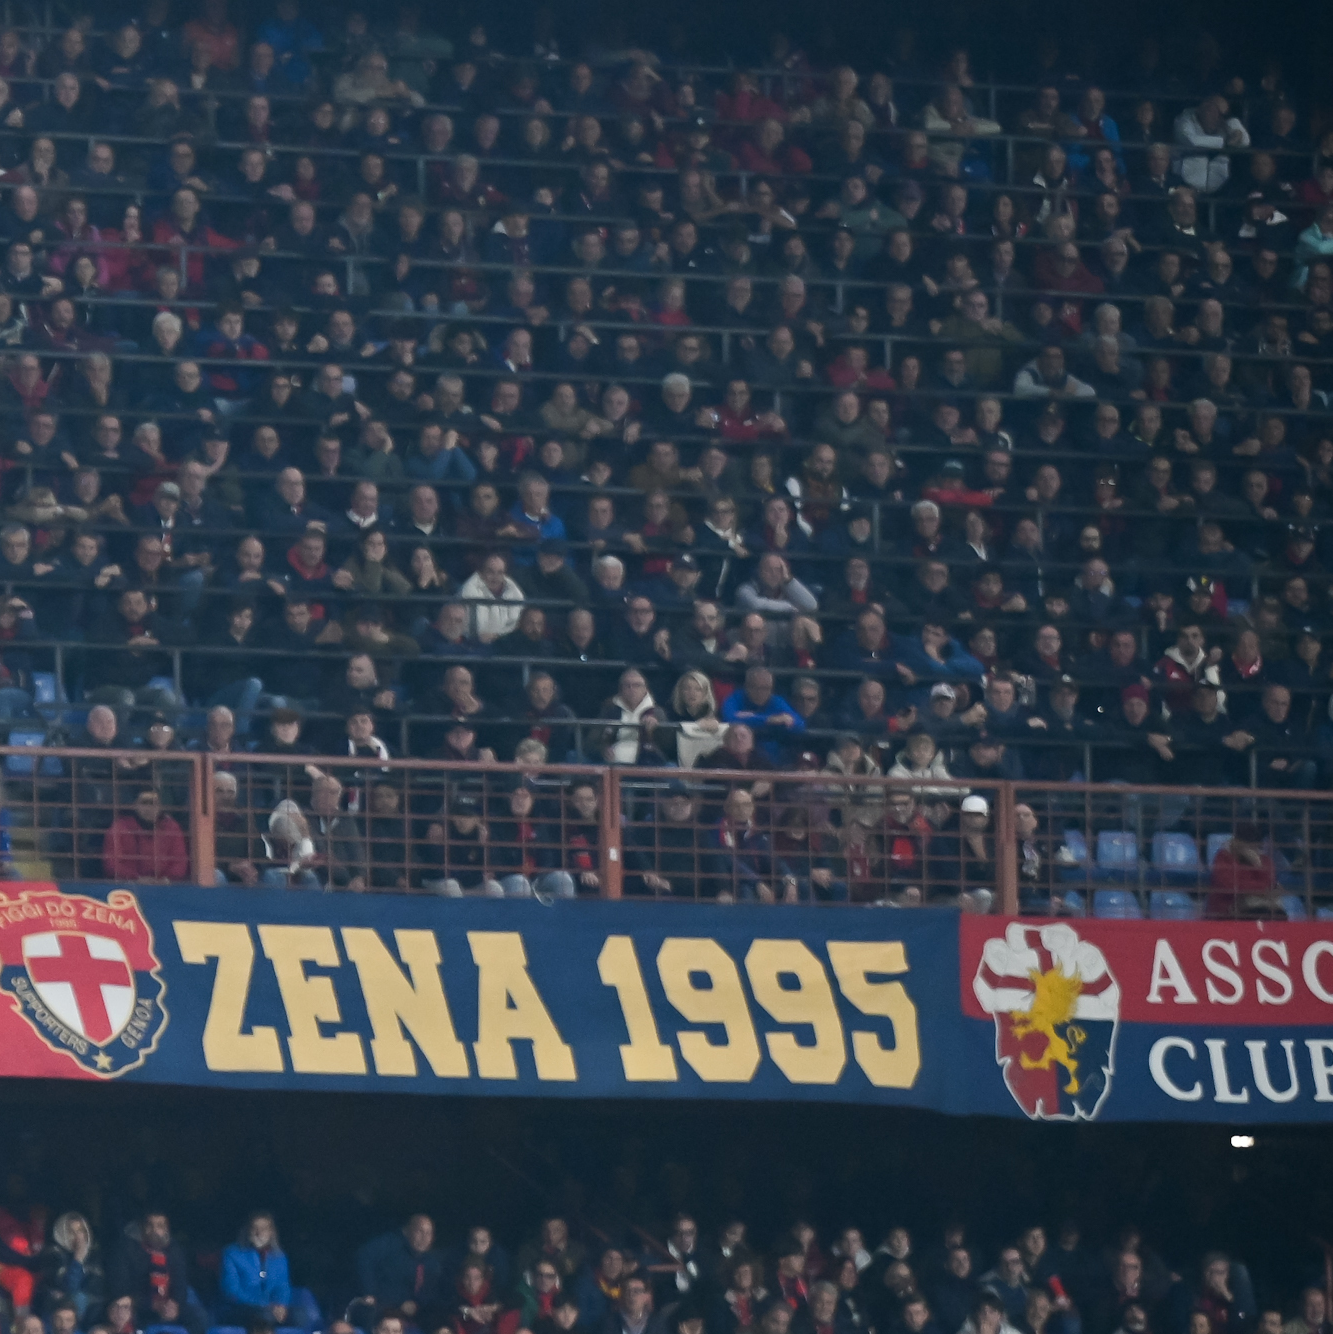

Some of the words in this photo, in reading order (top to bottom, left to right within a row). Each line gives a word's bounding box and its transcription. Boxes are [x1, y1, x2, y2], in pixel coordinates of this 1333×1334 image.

[81, 902, 137, 935] ZENA
[11, 976, 90, 1056] SUPPORTERS
[120, 998, 153, 1049] GENOA
[171, 920, 578, 1082] ZENA
[596, 934, 921, 1090] 1995
